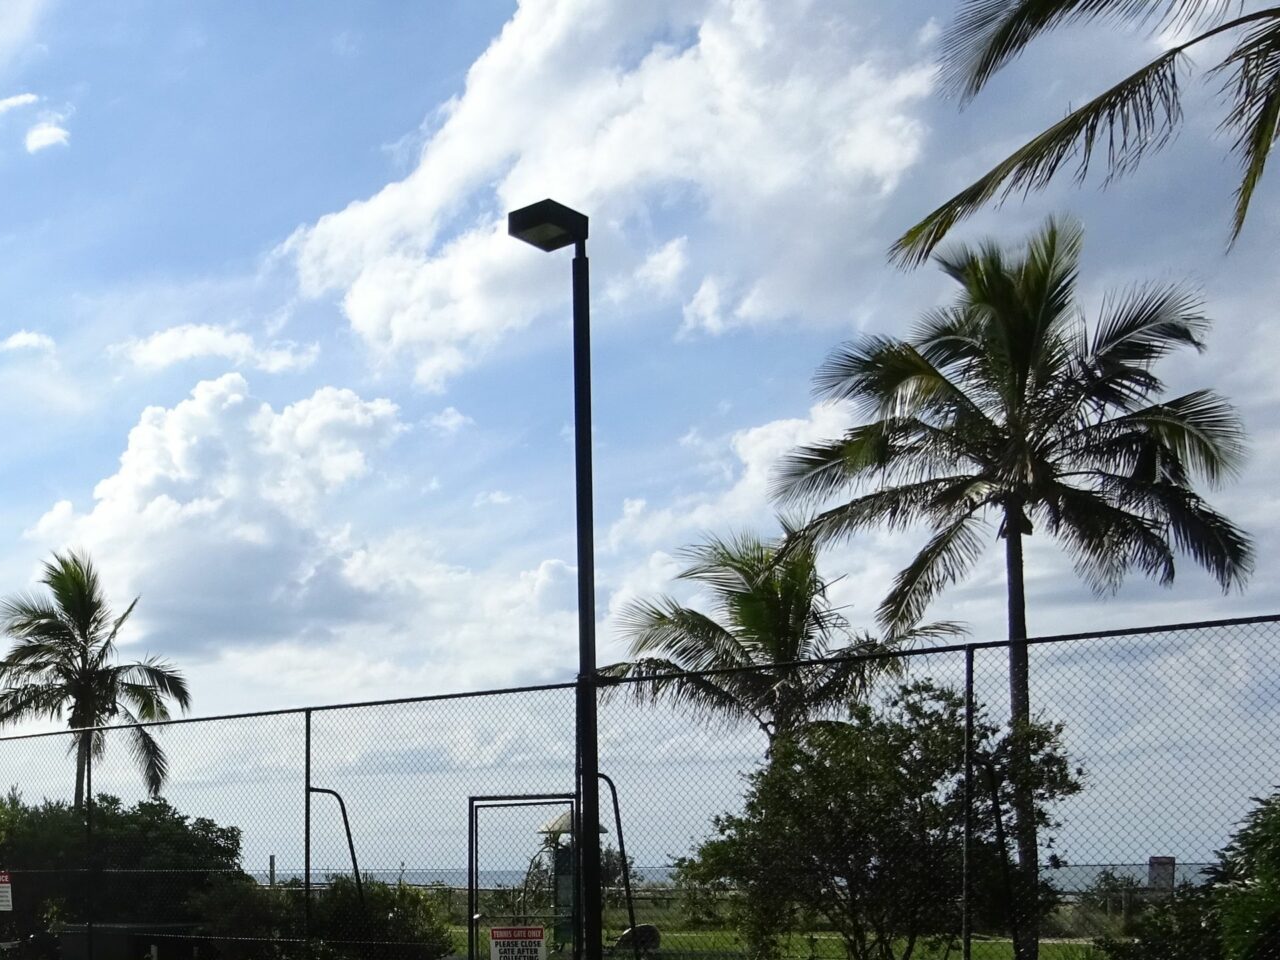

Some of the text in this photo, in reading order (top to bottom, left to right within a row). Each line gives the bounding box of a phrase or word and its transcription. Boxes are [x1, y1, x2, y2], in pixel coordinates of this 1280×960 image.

[493, 930, 542, 938] TENNIS GATE ONLY
